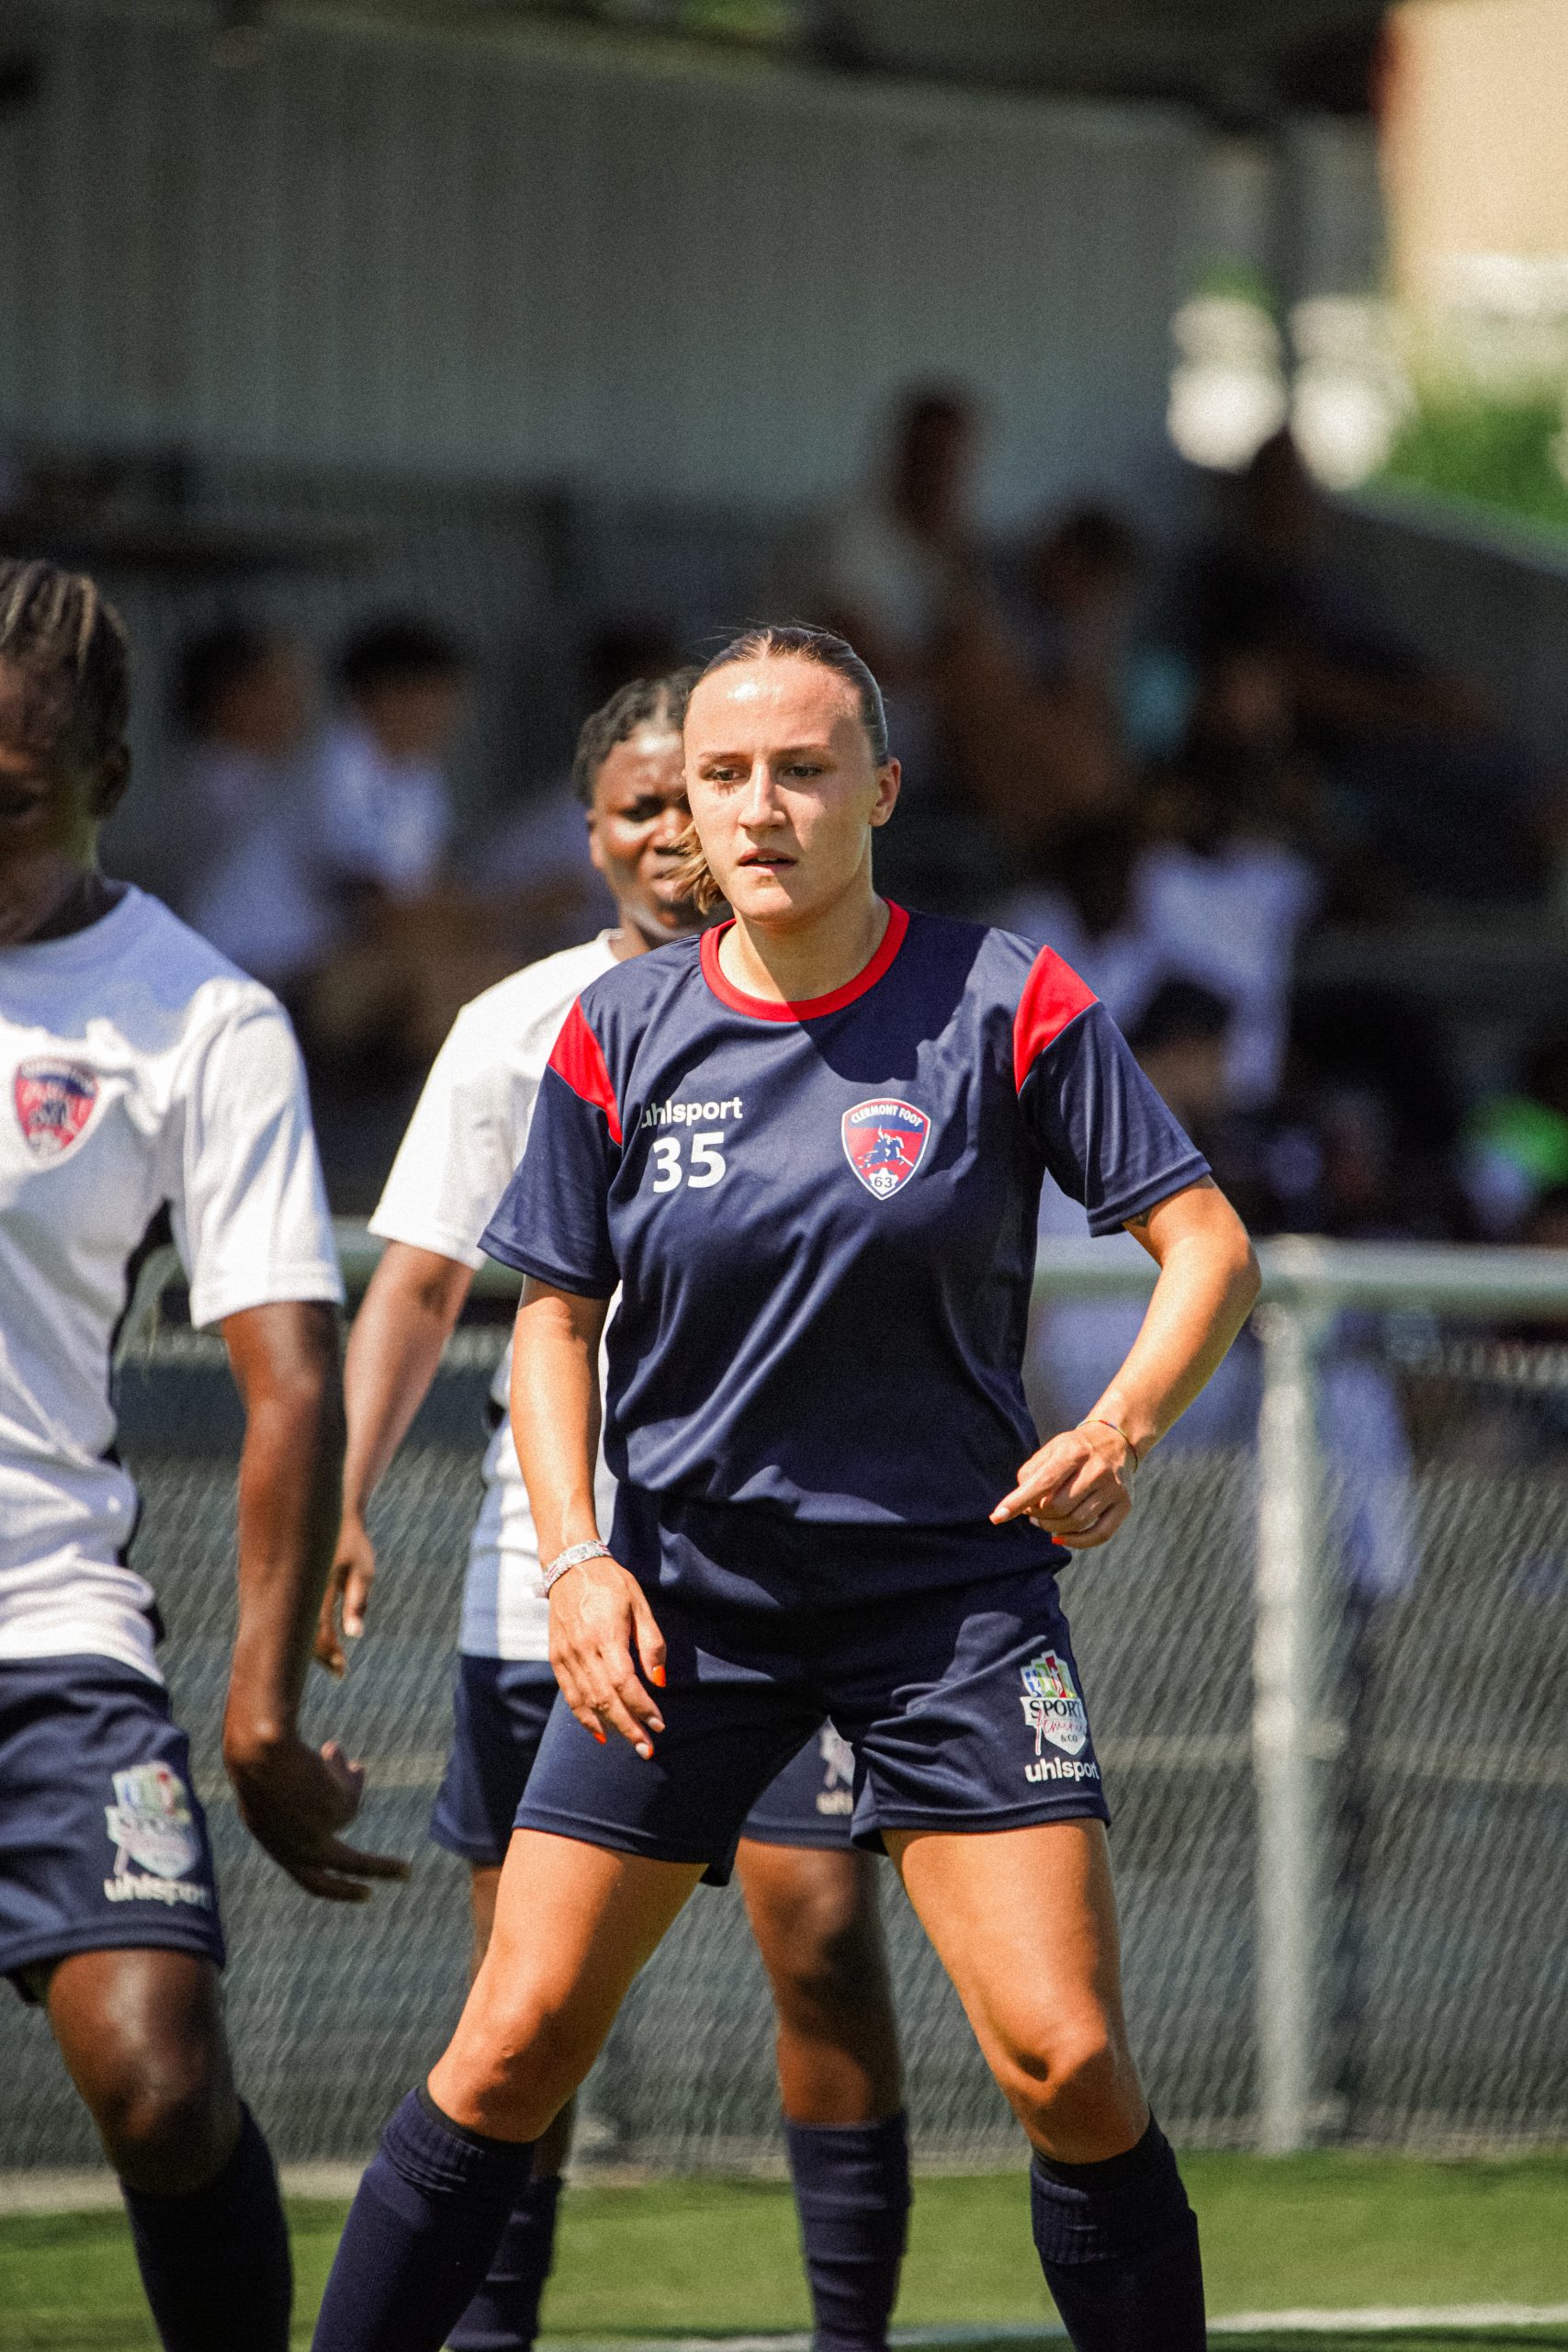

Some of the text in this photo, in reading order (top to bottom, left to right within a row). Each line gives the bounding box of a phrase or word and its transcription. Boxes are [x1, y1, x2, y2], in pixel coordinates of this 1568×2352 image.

[851, 1104, 924, 1127] CLERMONT FOOT
[652, 1131, 727, 1193] 35
[874, 1177, 893, 1188] 63
[1029, 1699, 1082, 1719] SPORT
[1024, 1756, 1100, 1782] uhlsport
